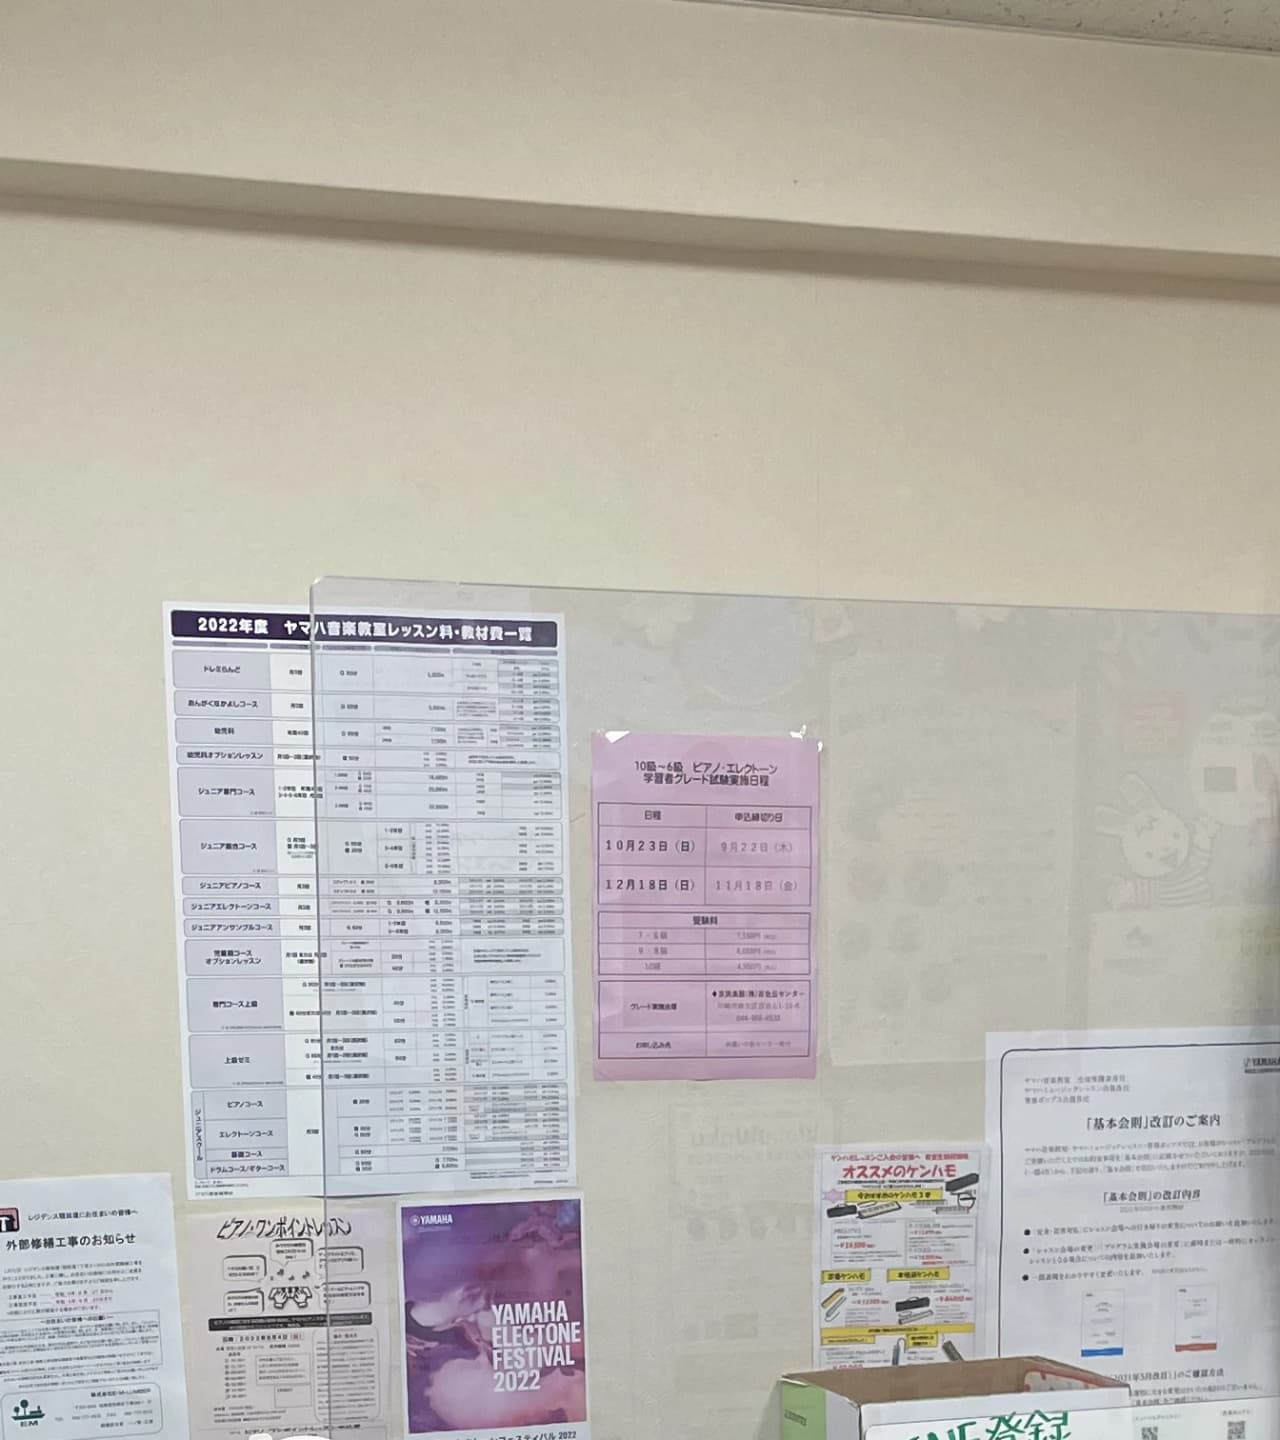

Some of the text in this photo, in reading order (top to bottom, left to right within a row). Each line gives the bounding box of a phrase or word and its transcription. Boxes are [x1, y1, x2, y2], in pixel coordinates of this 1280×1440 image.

[197, 617, 269, 635] 2022年度
[692, 761, 778, 775] ピアノ・エレクトーン
[1085, 1114, 1221, 1131] 「基本会則」改訂のご案内
[219, 1130, 273, 1138] エレクトーンコース
[843, 1164, 957, 1179] オススメのケンハモ
[420, 1214, 453, 1225] YAMAHA
[6, 1233, 136, 1251] 外部修繕工事のお知らせ
[491, 1301, 568, 1325] YAMAHA
[492, 1321, 581, 1348] ELECTONE
[493, 1345, 576, 1371] FESTIVAL
[493, 1369, 541, 1392] 2022
[558, 1431, 577, 1440] 2022
